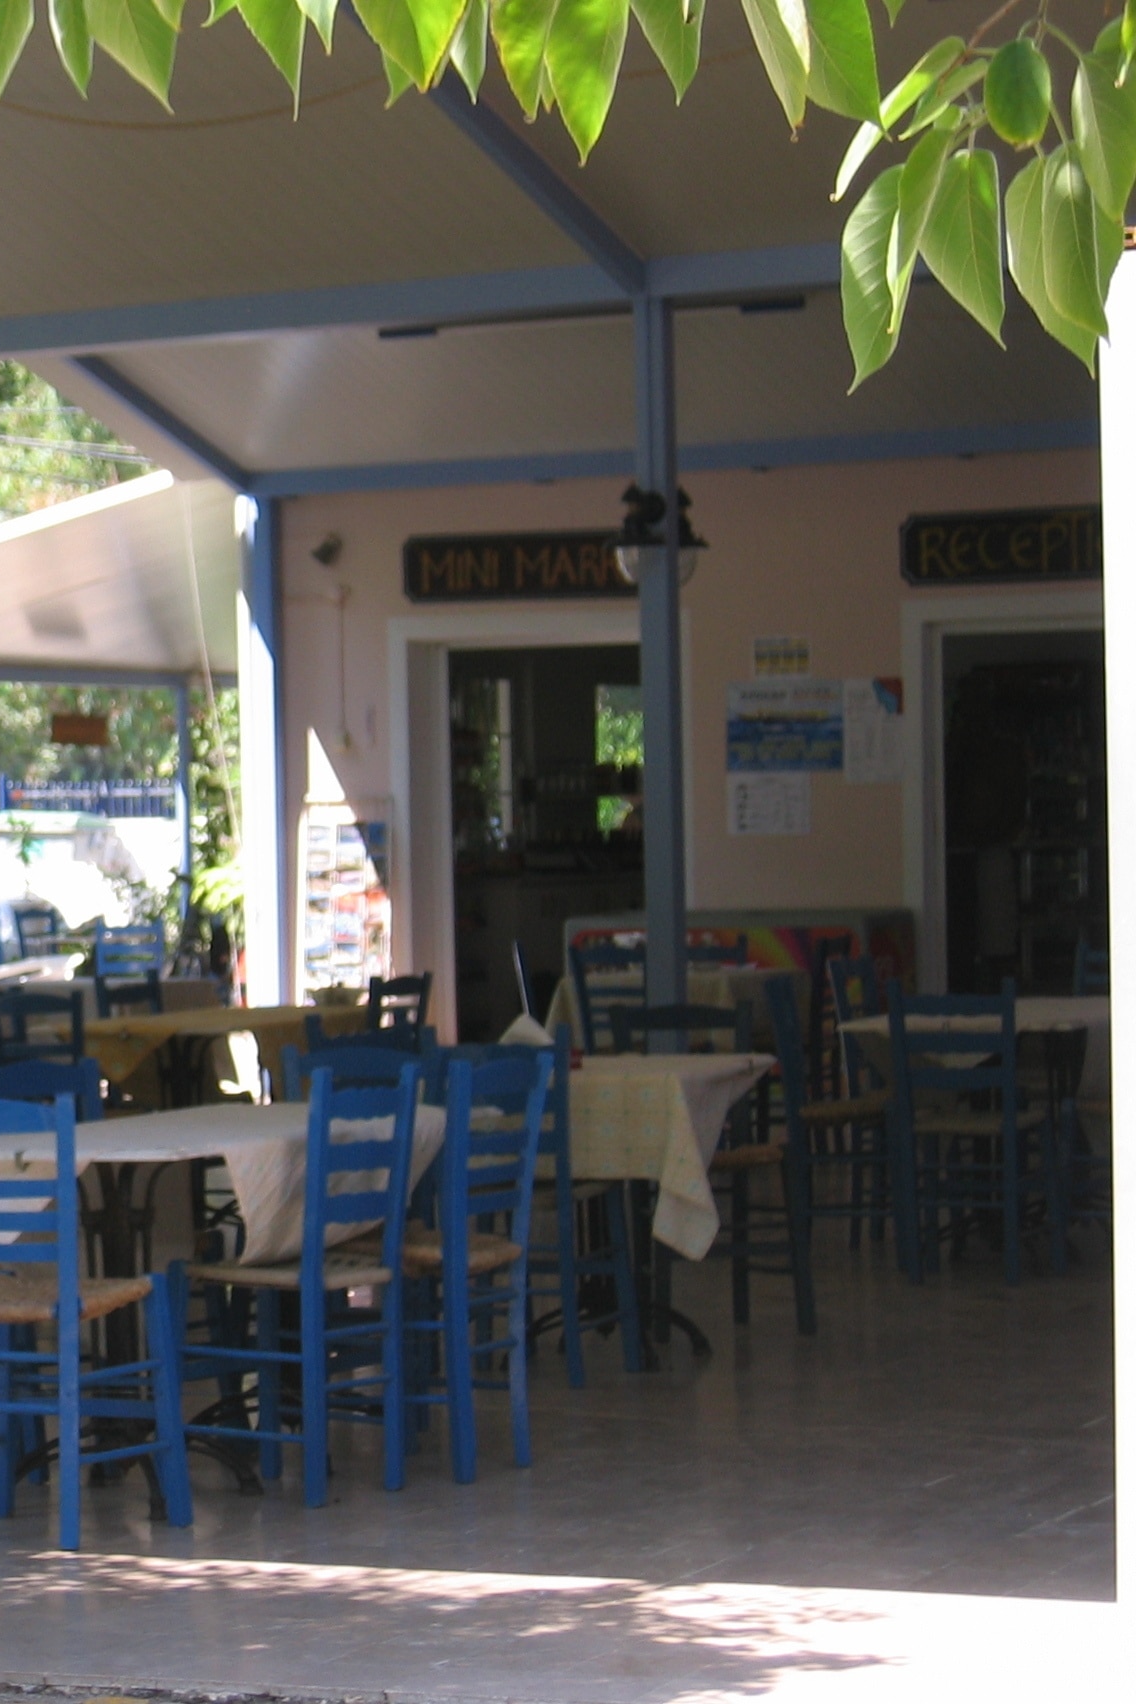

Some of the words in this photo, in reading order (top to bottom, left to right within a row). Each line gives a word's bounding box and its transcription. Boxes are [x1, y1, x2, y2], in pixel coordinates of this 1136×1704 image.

[419, 547, 500, 594] MINI
[513, 543, 622, 589] MARK
[918, 511, 1101, 576] RECEPTI
